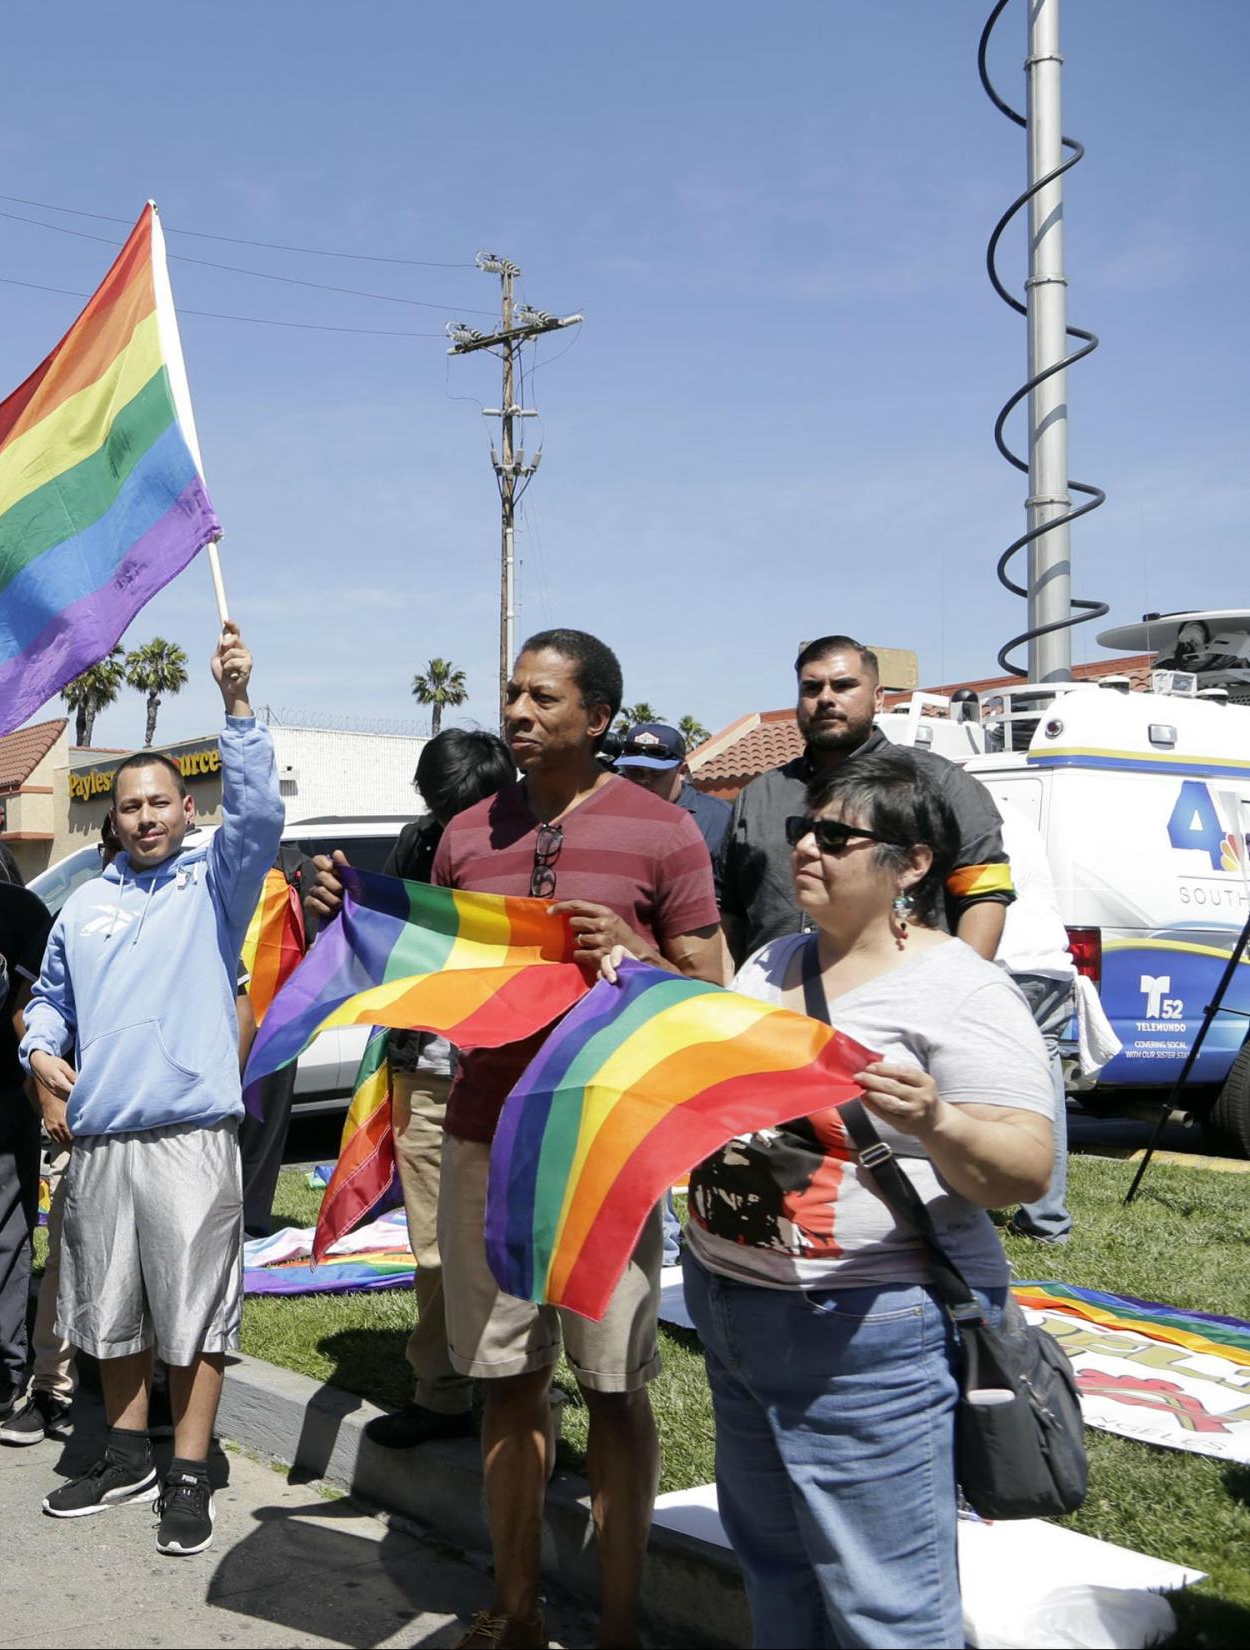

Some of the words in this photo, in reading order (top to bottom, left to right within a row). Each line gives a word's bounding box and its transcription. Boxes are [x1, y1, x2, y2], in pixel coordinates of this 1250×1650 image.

[67, 768, 116, 800] Payles
[1161, 1000, 1184, 1019] 52
[1135, 1022, 1187, 1033] TELEMUNDO
